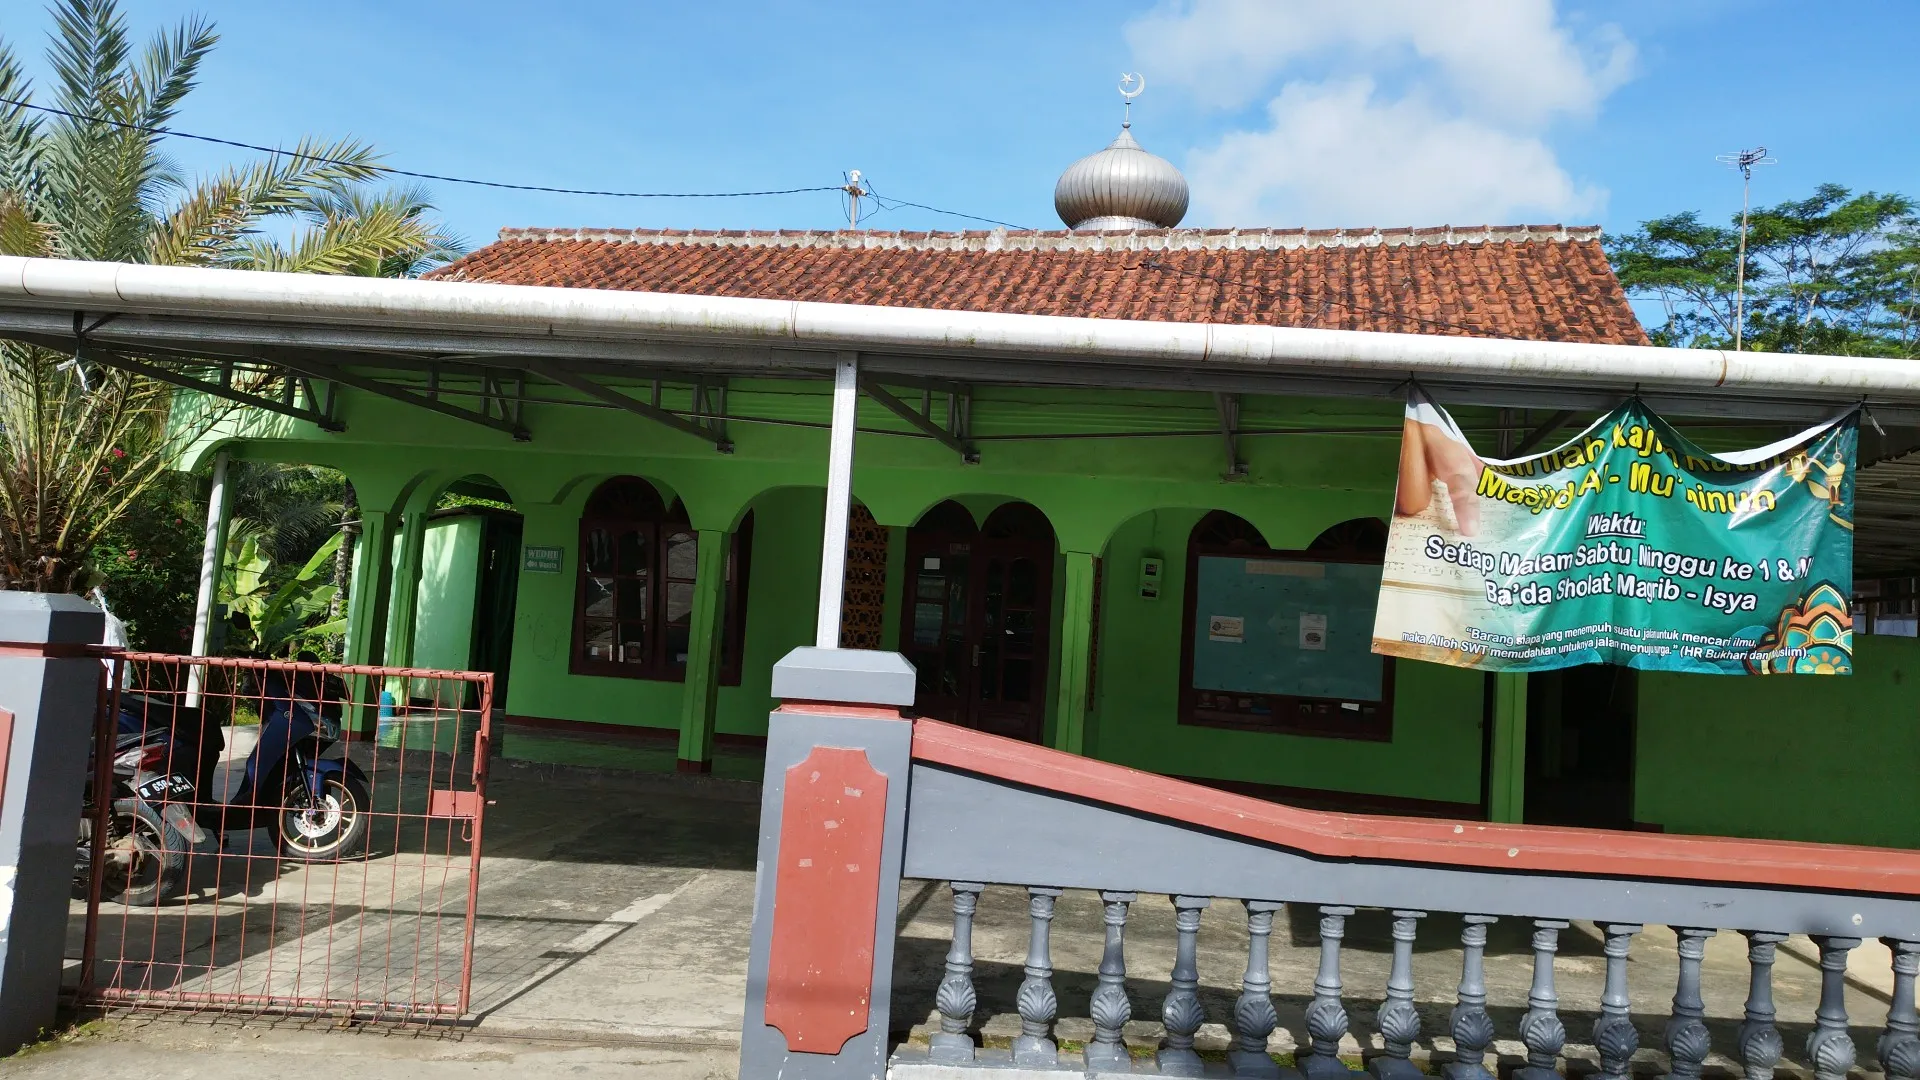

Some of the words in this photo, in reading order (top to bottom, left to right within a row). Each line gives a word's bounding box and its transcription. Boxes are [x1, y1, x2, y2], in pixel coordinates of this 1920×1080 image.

[1612, 423, 1680, 469] Kajn
[1477, 465, 1576, 515] Masjid
[1425, 534, 1495, 577] Setiap
[1499, 551, 1573, 577] Malam
[1574, 540, 1631, 567] Sabtu
[1721, 555, 1753, 581] ke
[1758, 558, 1770, 581] 1
[1776, 557, 1796, 581] &
[1556, 572, 1614, 601] Sholat
[1616, 572, 1680, 604] Magrib
[1702, 585, 1758, 615] Isya
[1402, 631, 1426, 644] maka
[1428, 634, 1458, 650] Alloh
[1460, 641, 1488, 655] SWT
[1490, 645, 1556, 659] memudahkan
[1558, 638, 1594, 654] untuknya
[1594, 637, 1619, 649] jalan
[1680, 645, 1703, 659] (HR
[1705, 649, 1747, 660] Bukhari
[1749, 650, 1768, 660] dan
[1541, 630, 1563, 645] yang
[1564, 621, 1612, 638] menempuh
[1614, 625, 1640, 638] suatu
[1681, 632, 1732, 647] mencari
[140, 787, 151, 798] R
